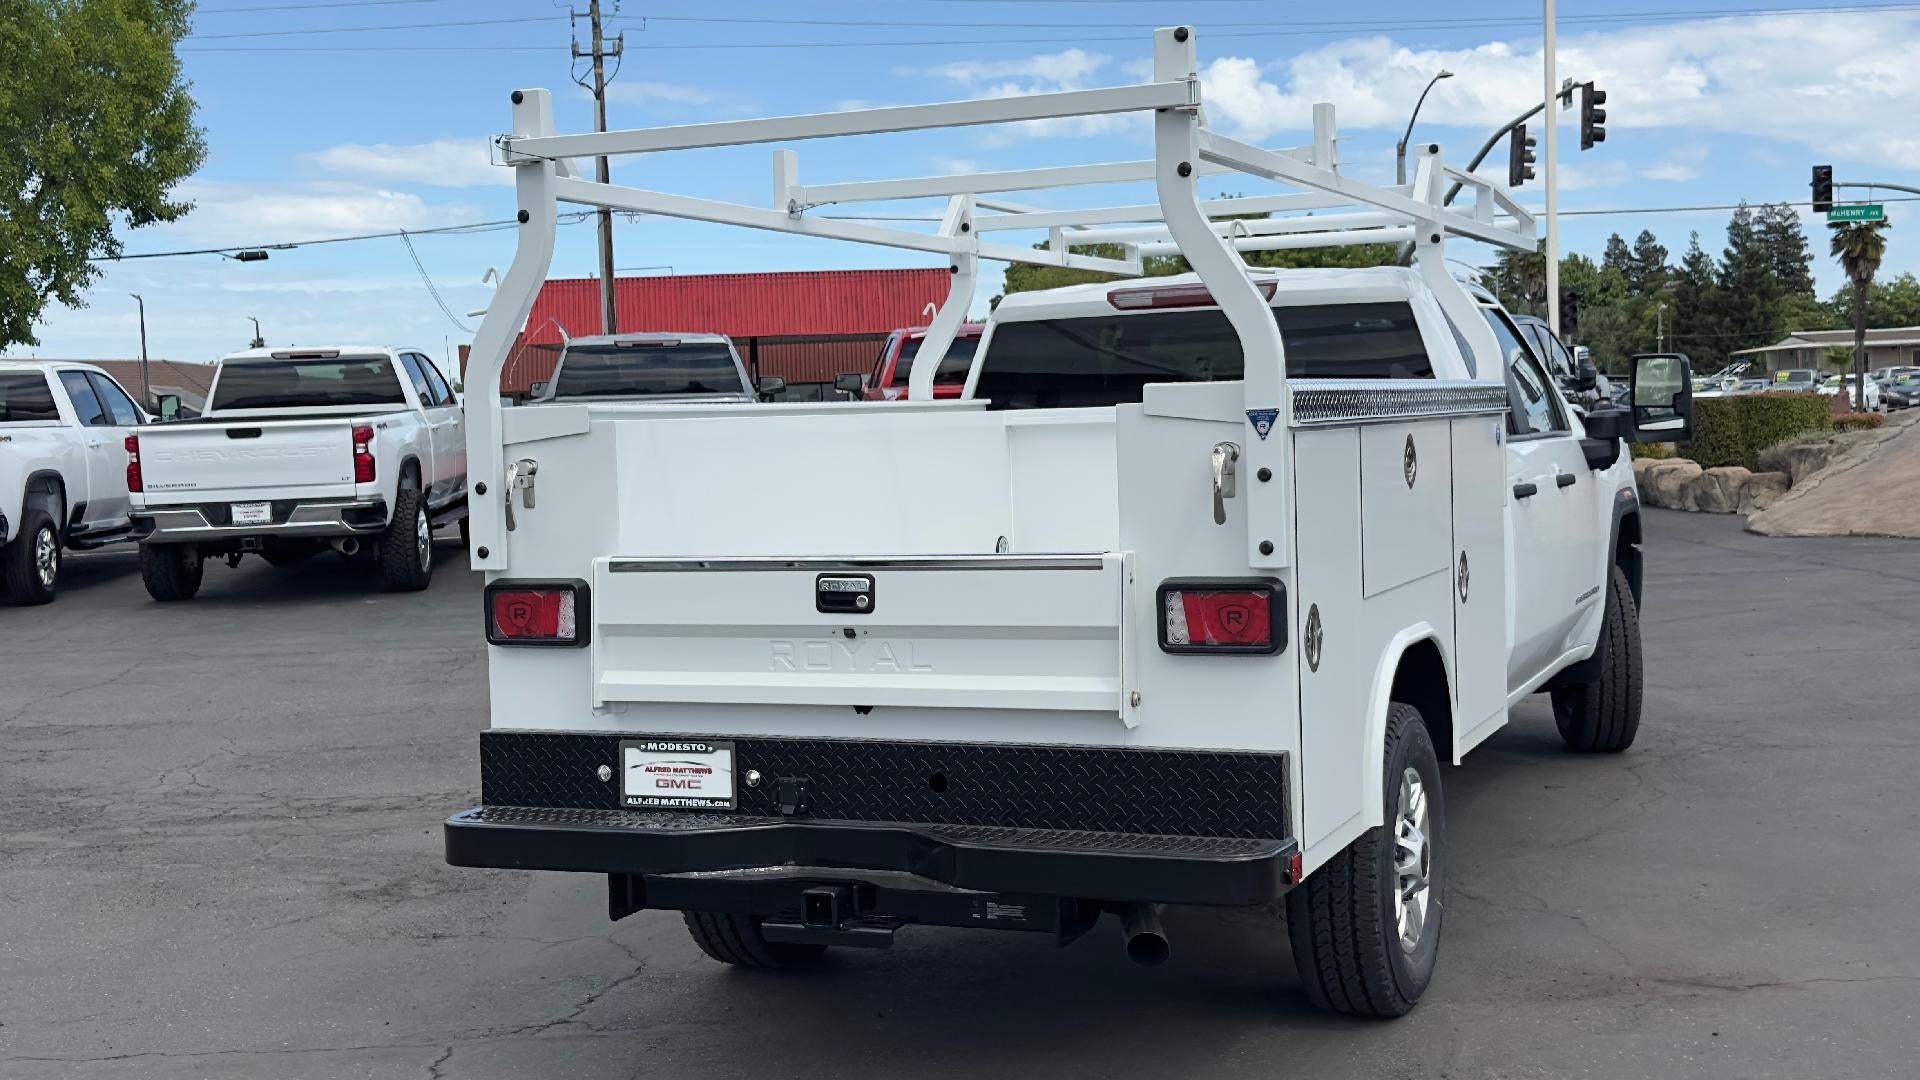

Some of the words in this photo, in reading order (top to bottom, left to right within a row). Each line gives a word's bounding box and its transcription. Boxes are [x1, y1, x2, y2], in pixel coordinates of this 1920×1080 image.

[821, 580, 867, 591] ROYAL
[768, 640, 932, 672] ROYAL
[647, 742, 706, 751] MODESTO
[655, 778, 702, 789] GMC
